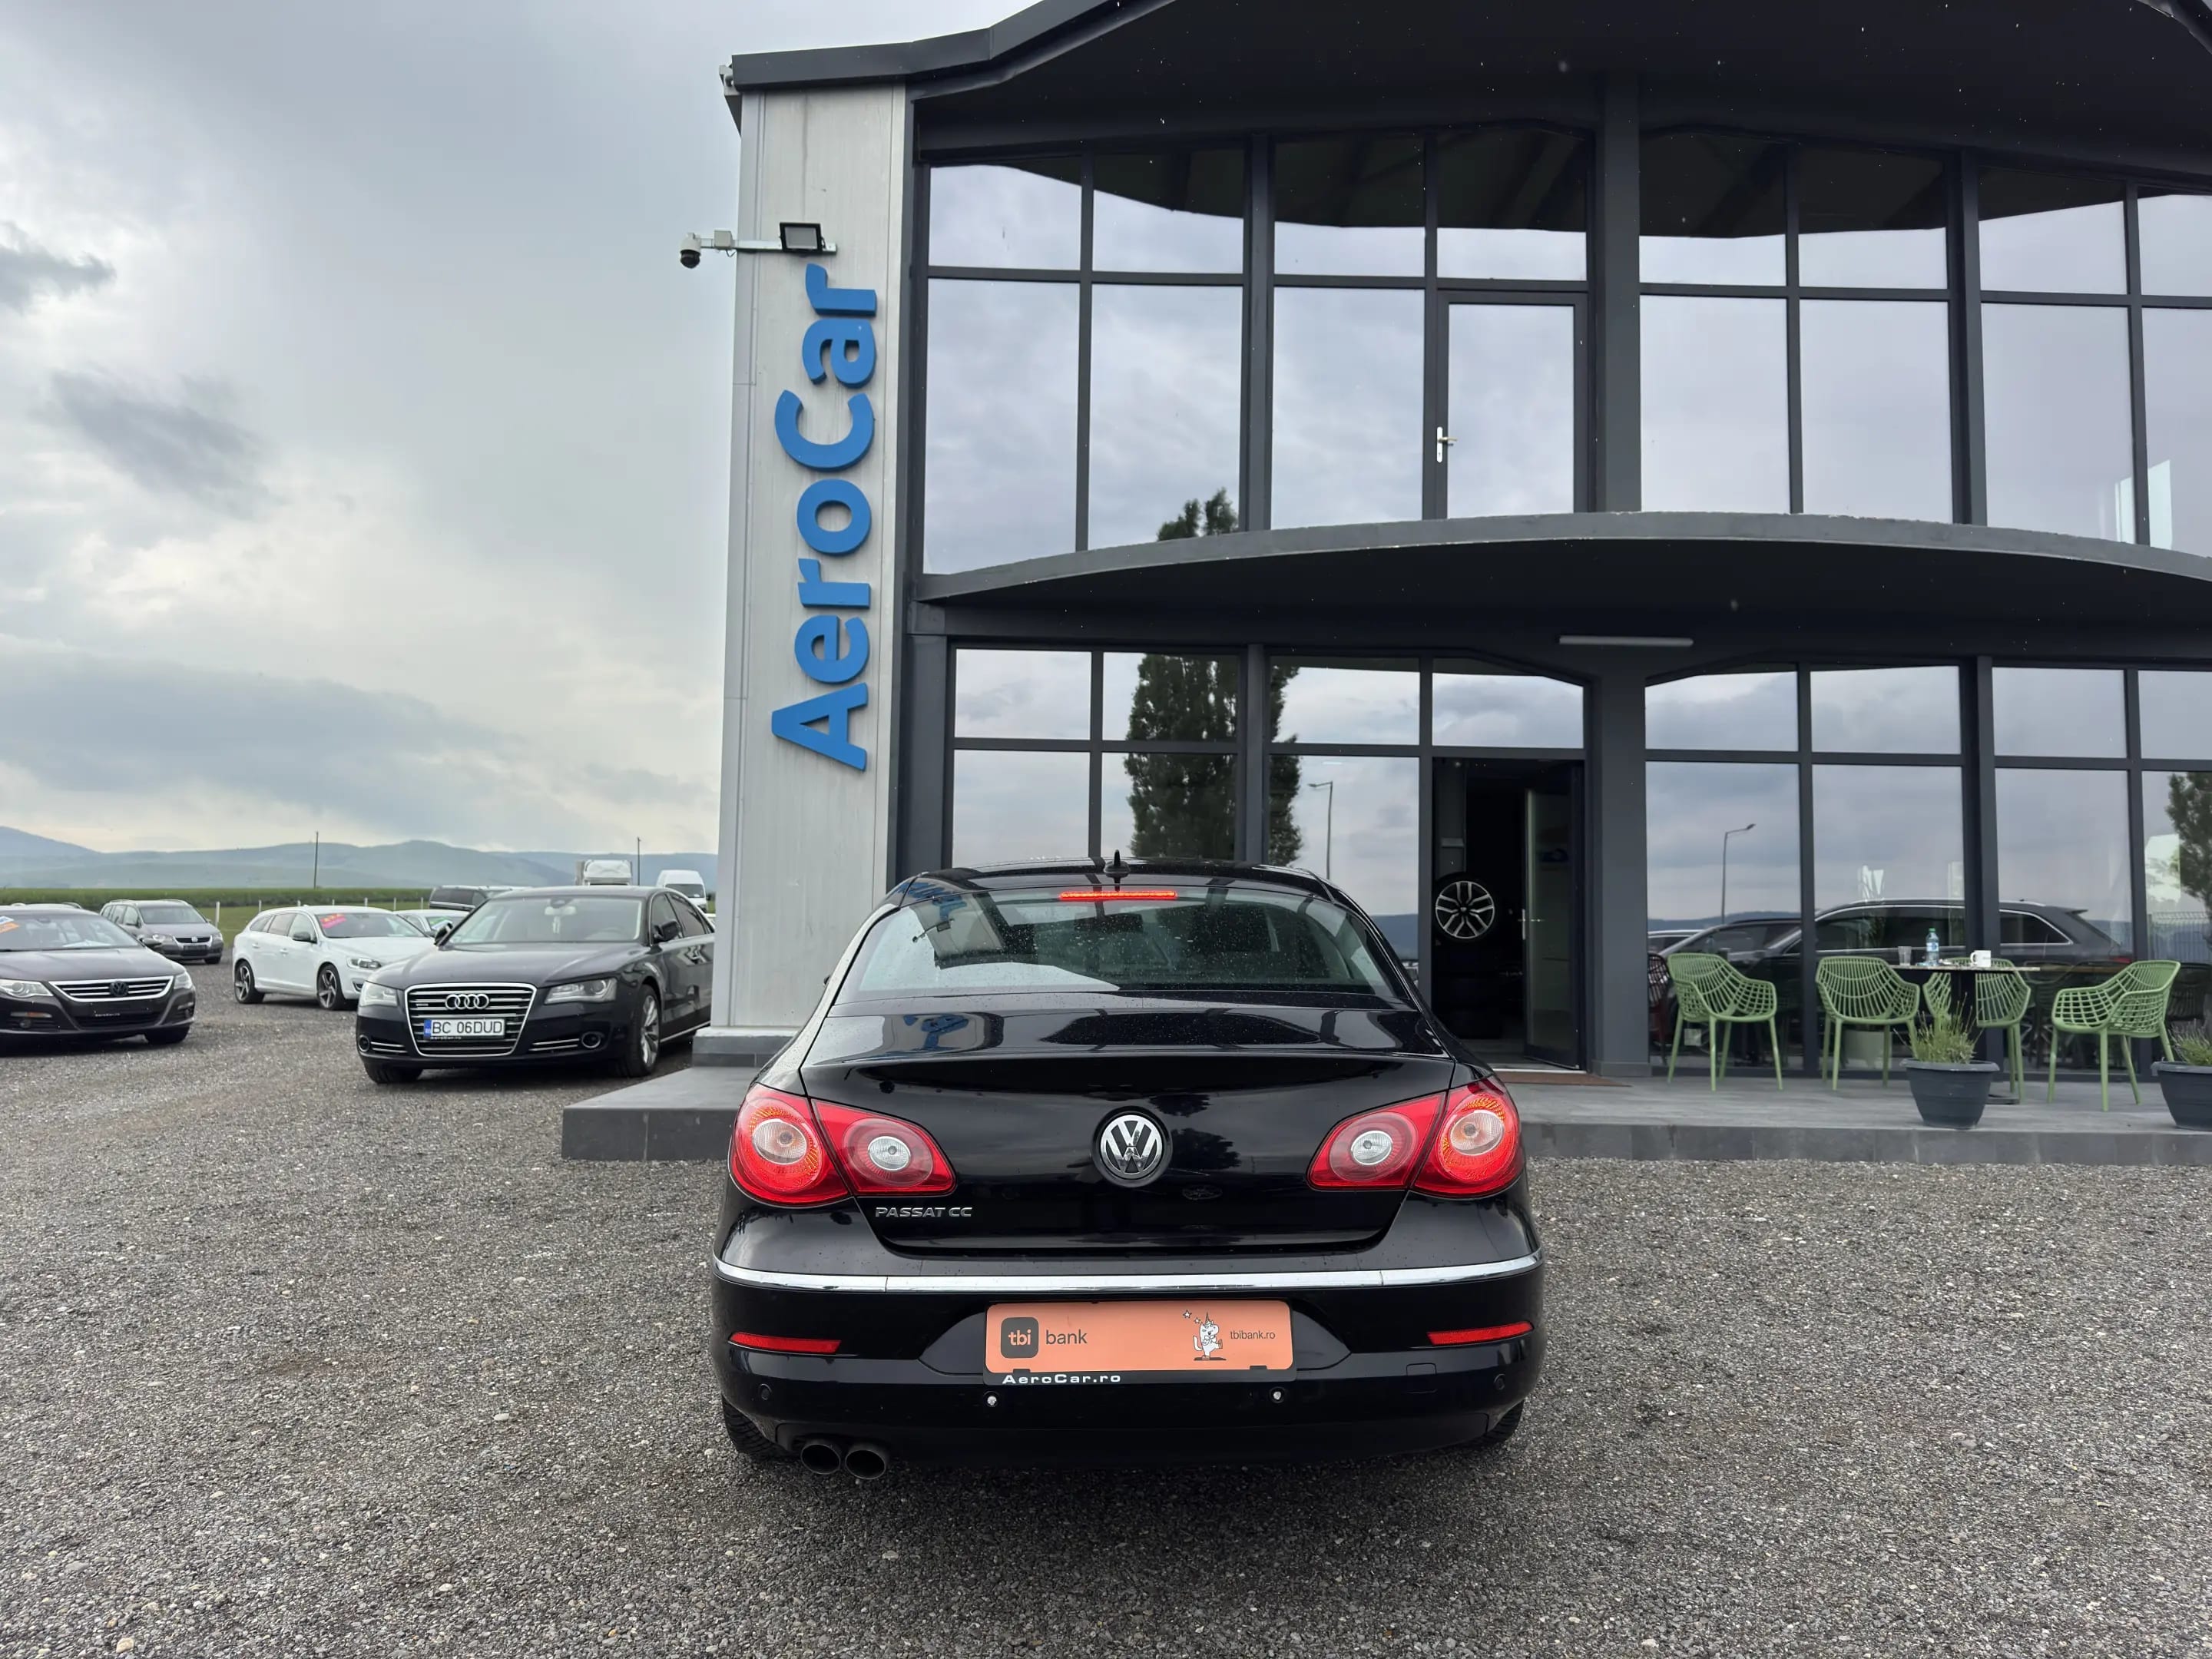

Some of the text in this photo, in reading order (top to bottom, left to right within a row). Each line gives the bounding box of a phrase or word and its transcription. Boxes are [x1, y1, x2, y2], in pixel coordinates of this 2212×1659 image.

[771, 263, 877, 772] AeroCar
[432, 1022, 451, 1035] BC
[875, 1207, 972, 1217] PASSAT CC
[1008, 1329, 1088, 1346] tbi bank
[1230, 1330, 1276, 1339] tbibank.ro
[1002, 1373, 1121, 1385] AeroCar.ro
